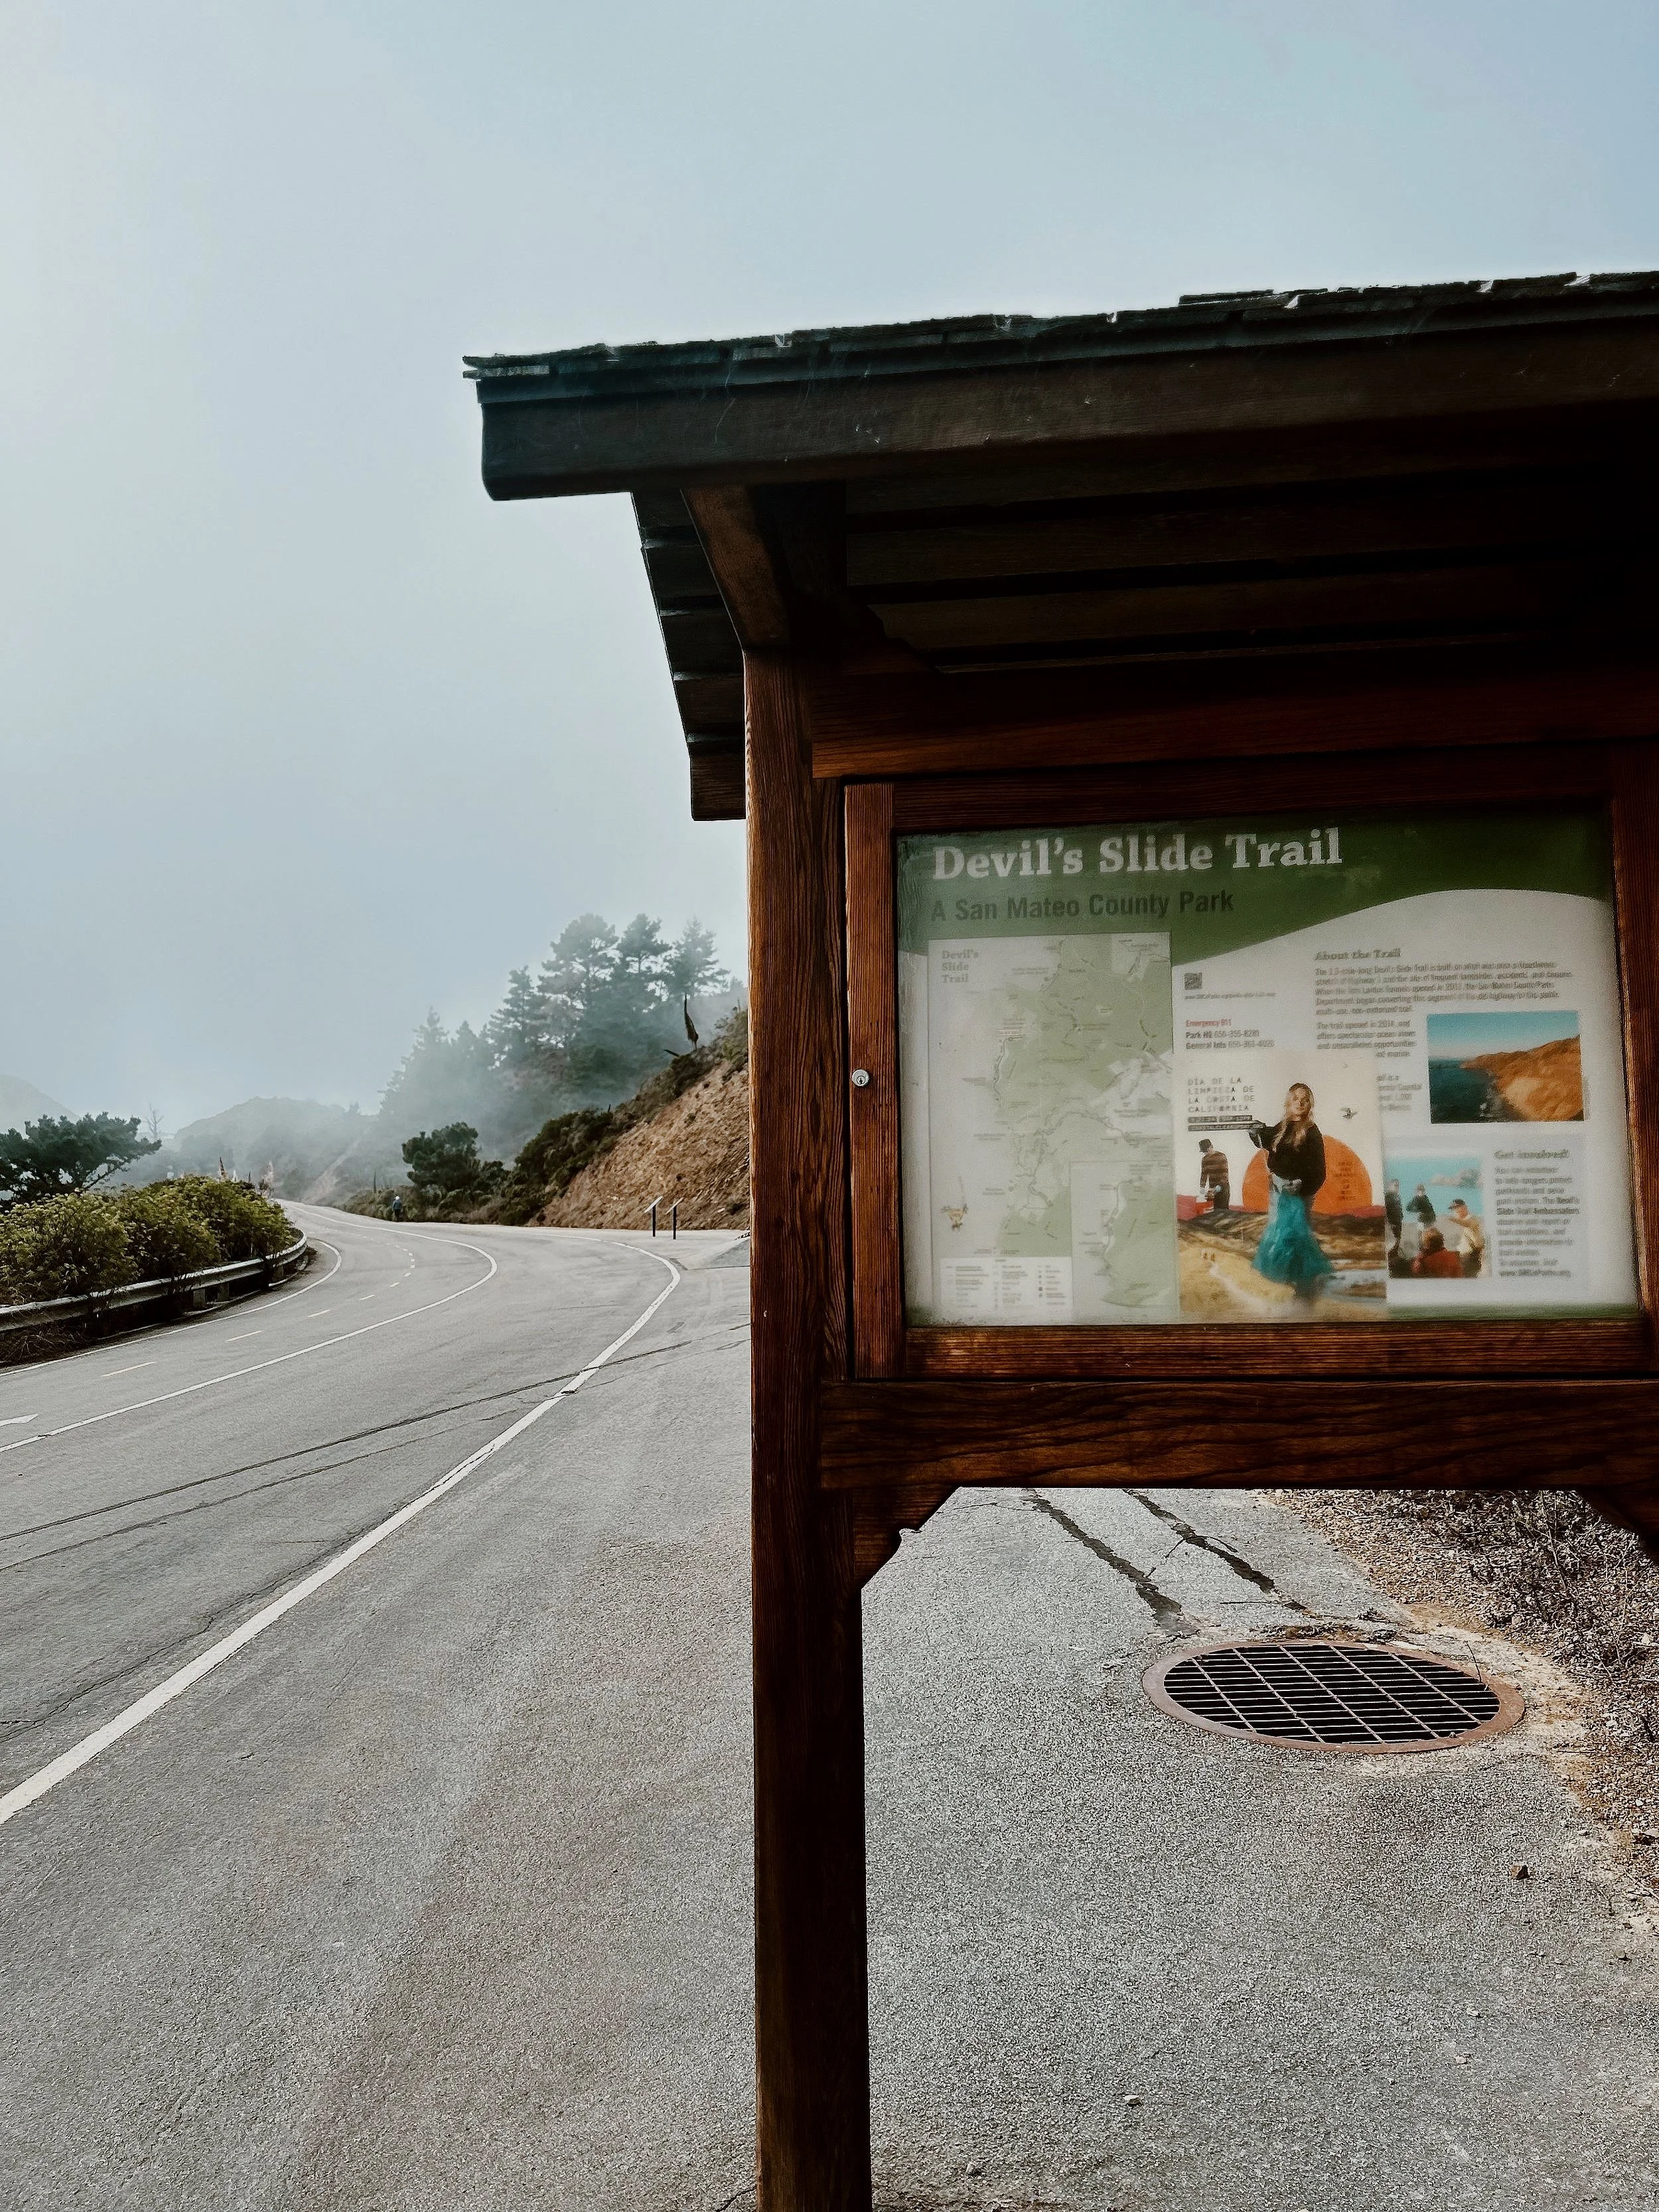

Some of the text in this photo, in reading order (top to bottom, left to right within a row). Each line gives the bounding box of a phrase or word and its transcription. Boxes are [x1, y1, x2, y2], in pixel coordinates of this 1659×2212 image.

[932, 828, 1343, 880] Devil's Slide Trail
[930, 889, 1235, 921] A San Mateo County Park
[942, 950, 979, 959] Devil's
[1315, 948, 1402, 960] About the Trail
[942, 962, 970, 972] Slide
[942, 974, 969, 984] Trail
[1186, 1019, 1220, 1028] Emergency
[1186, 1041, 1212, 1050] General
